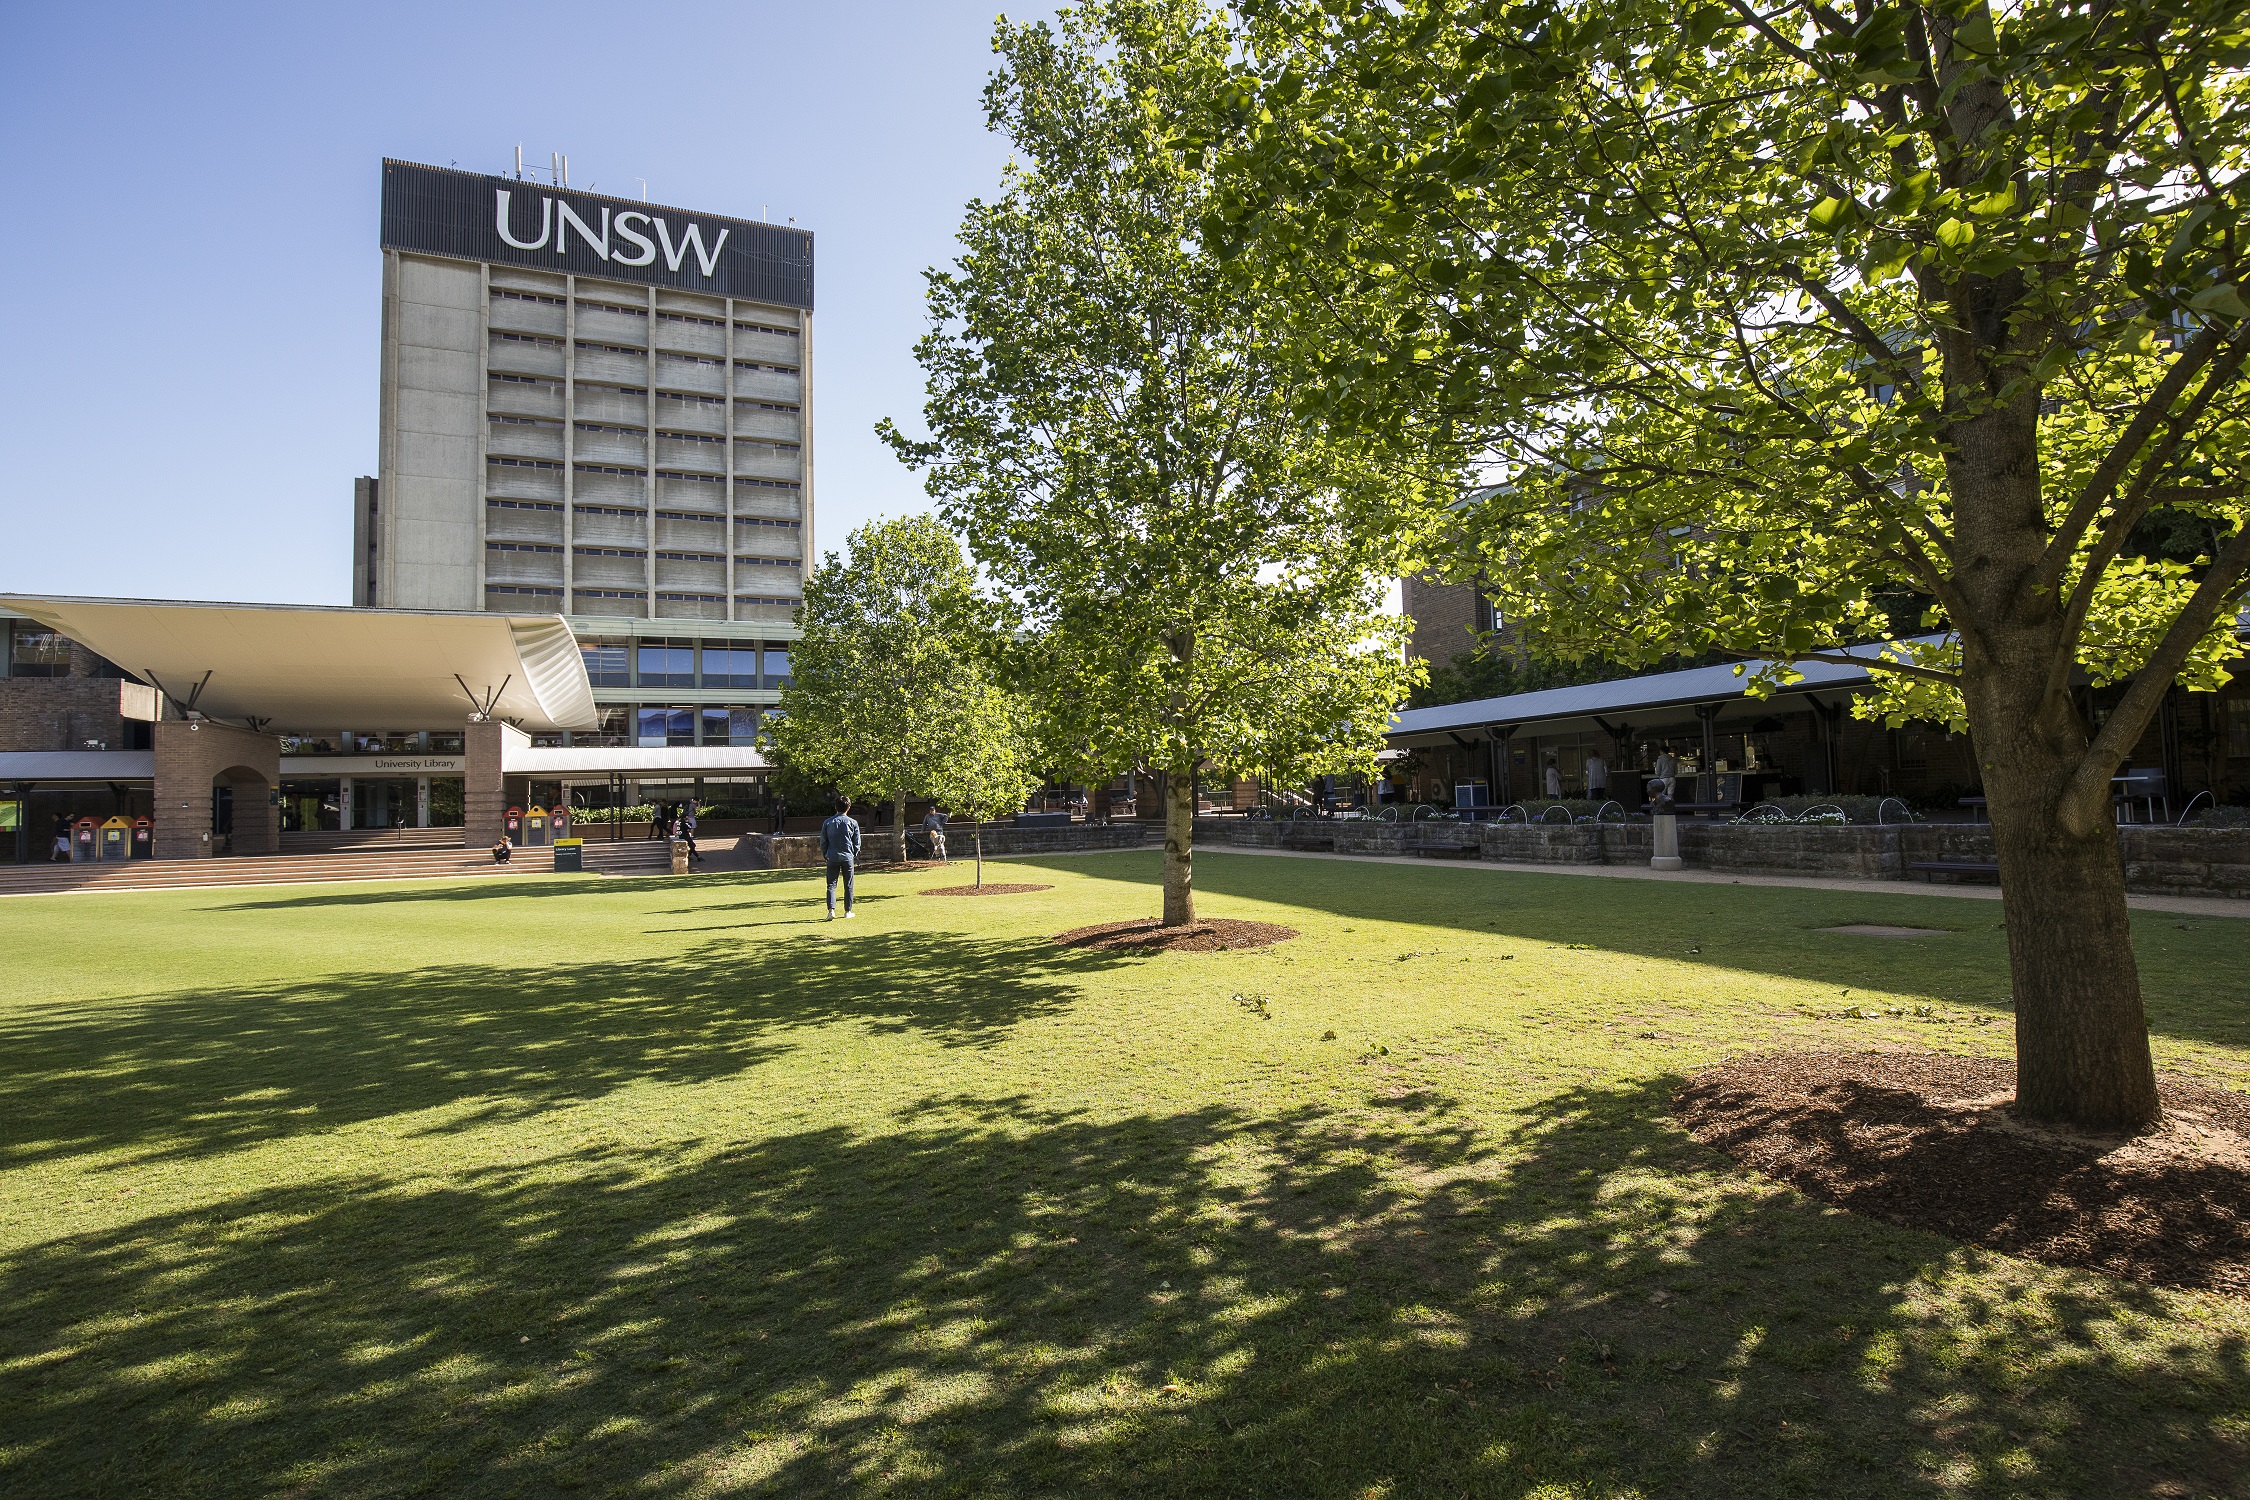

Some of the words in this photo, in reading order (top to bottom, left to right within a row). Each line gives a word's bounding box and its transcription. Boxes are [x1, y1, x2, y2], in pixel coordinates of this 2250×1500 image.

[496, 189, 729, 277] UNSW
[375, 760, 422, 769] University
[424, 759, 456, 769] Library
